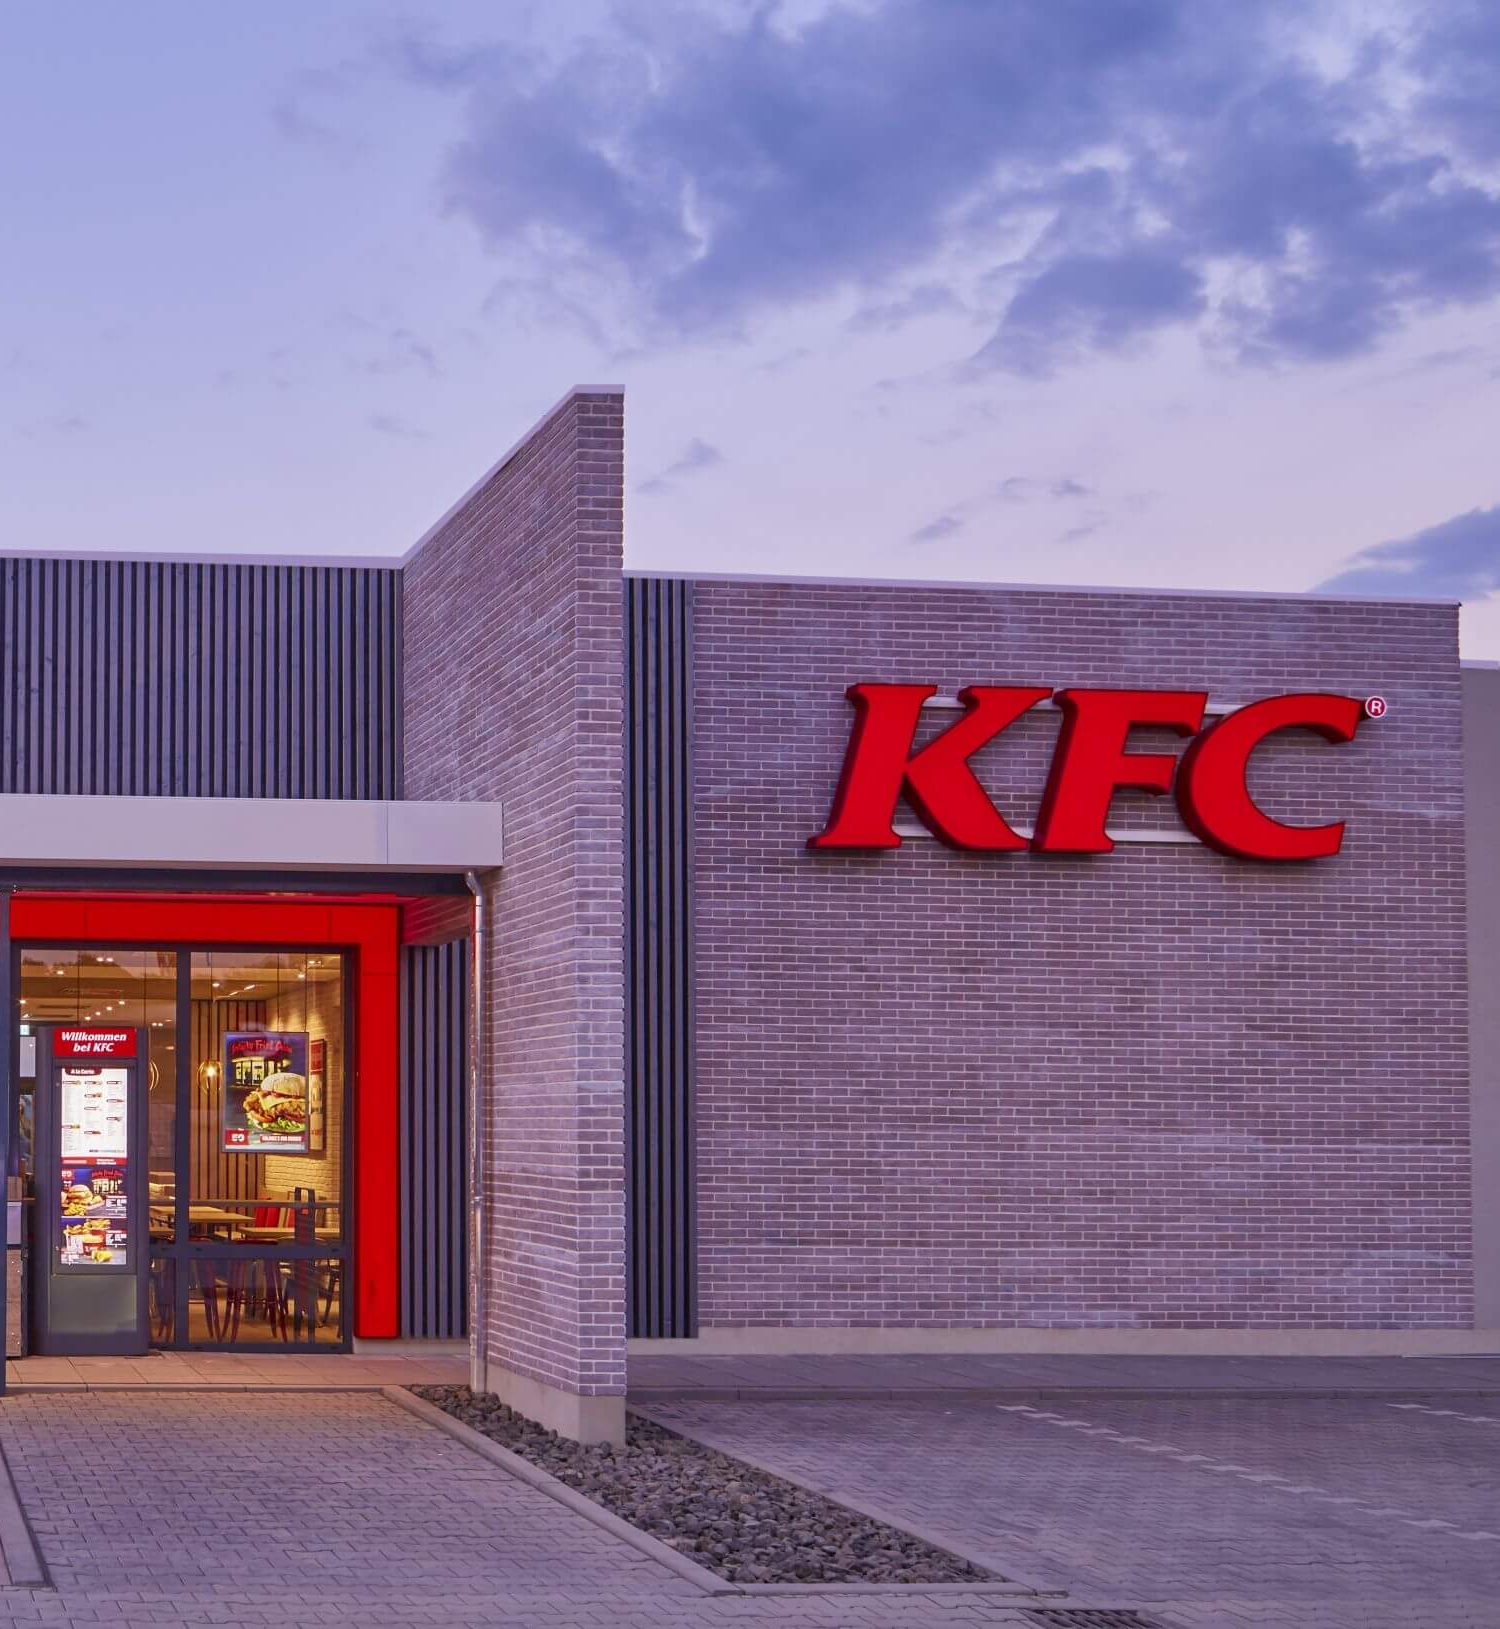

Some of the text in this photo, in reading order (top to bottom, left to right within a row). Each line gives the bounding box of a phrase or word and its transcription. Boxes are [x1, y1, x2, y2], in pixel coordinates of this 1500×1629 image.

[61, 1031, 127, 1042] Willkommen
[73, 1043, 114, 1052] bei KFC
